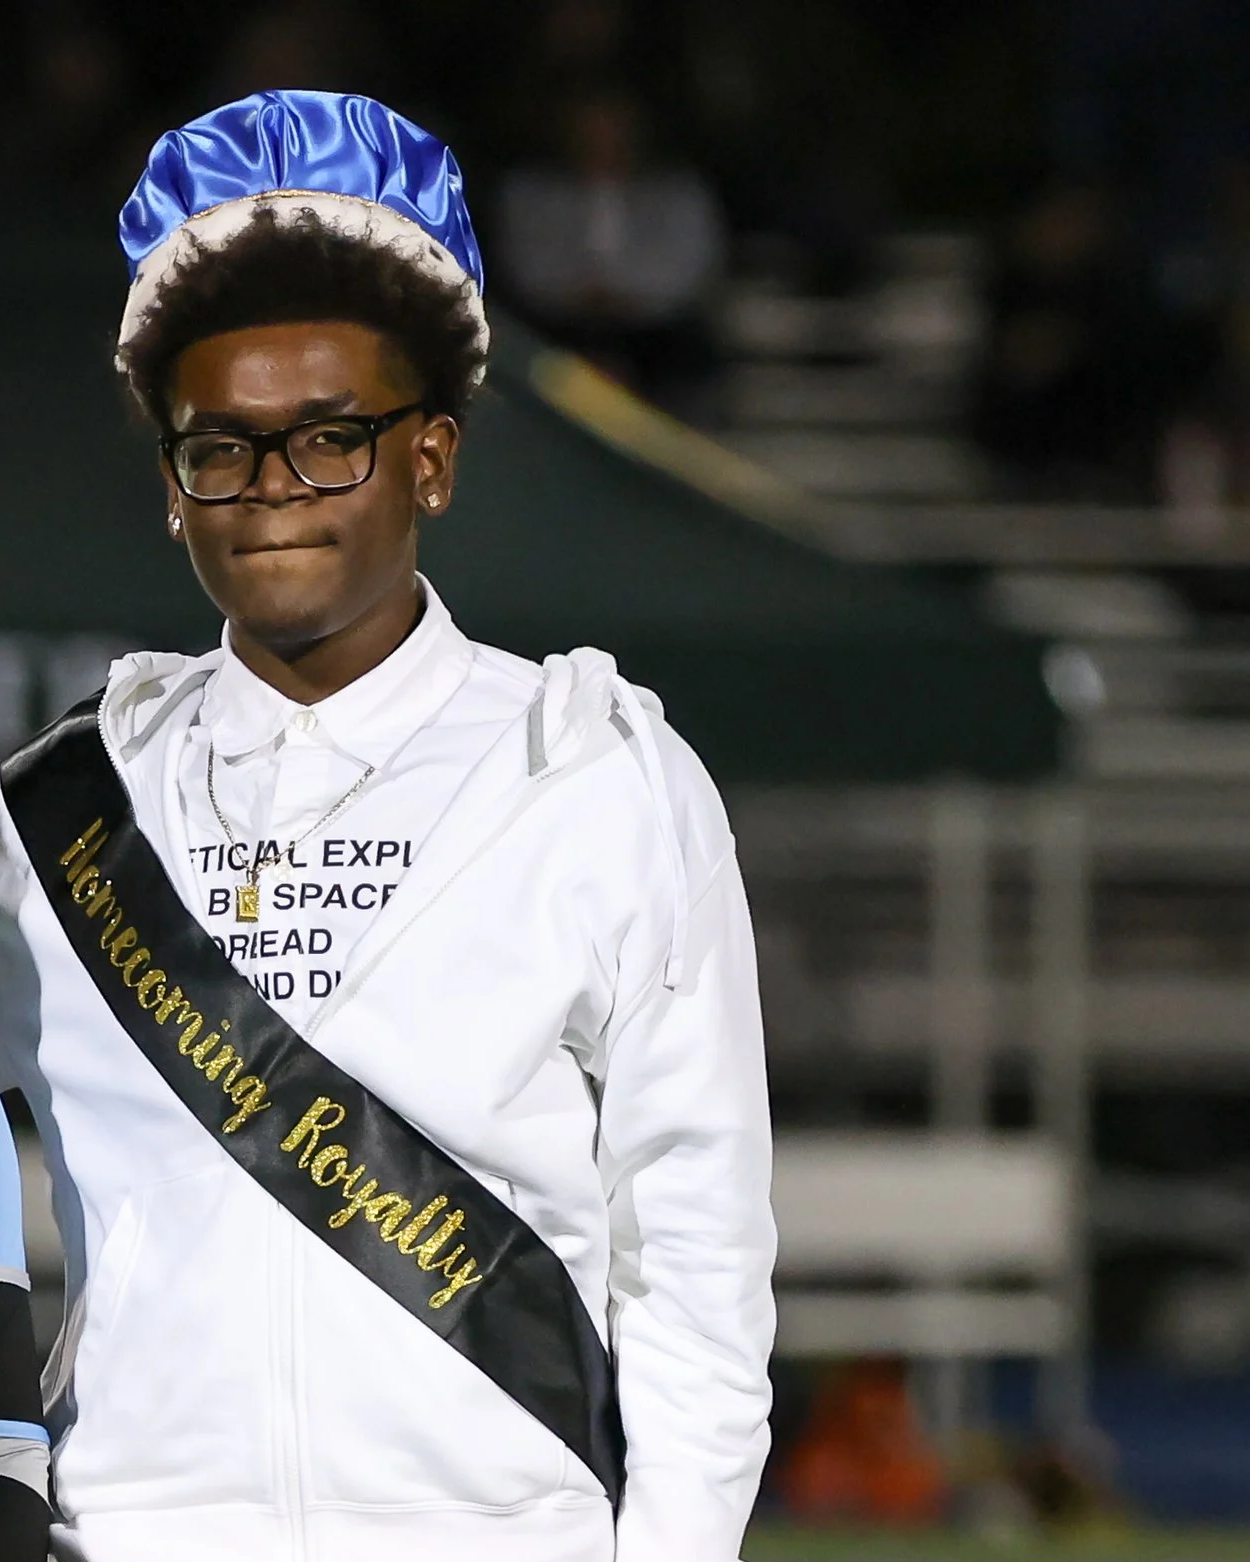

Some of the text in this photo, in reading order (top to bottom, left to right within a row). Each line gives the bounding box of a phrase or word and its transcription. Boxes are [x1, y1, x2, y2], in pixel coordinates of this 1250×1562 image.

[189, 840, 307, 873] TICAL
[254, 972, 295, 1001] ND
[61, 818, 482, 1309] Homecoming Royalty
